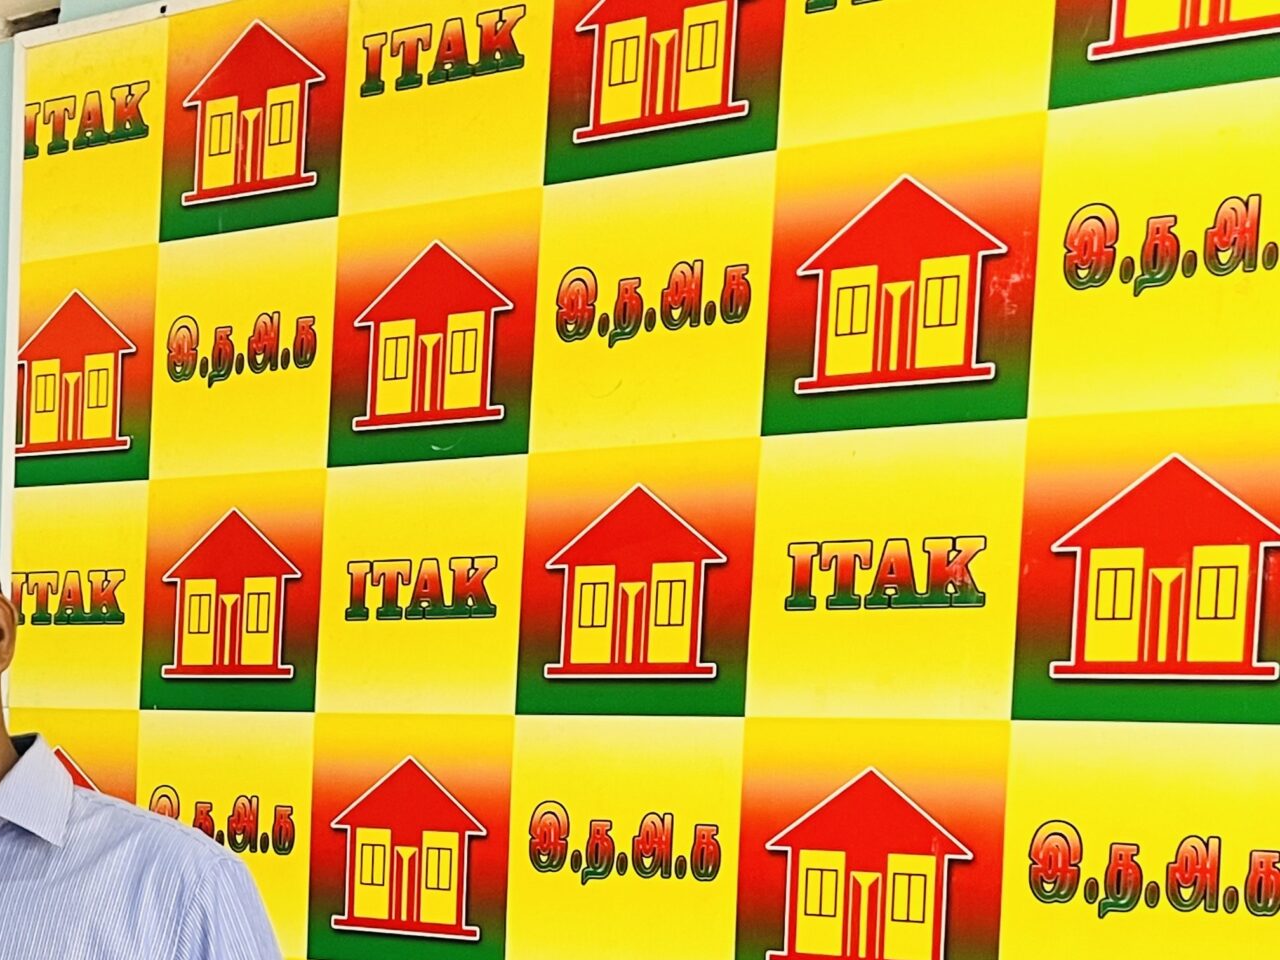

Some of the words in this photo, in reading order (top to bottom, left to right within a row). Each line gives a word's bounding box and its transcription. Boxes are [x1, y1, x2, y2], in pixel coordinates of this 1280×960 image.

[360, 5, 526, 97] ITAK
[23, 80, 150, 160] ITAK
[556, 260, 752, 349] இ.த.அ.க
[166, 312, 317, 389] இ.த.அ.க
[11, 569, 125, 625] ITAK
[344, 556, 498, 621] ITAK
[784, 536, 987, 611] ITAK
[528, 800, 721, 885] இ.த.அ.க
[1028, 819, 1280, 918] இ.த.அ.க
